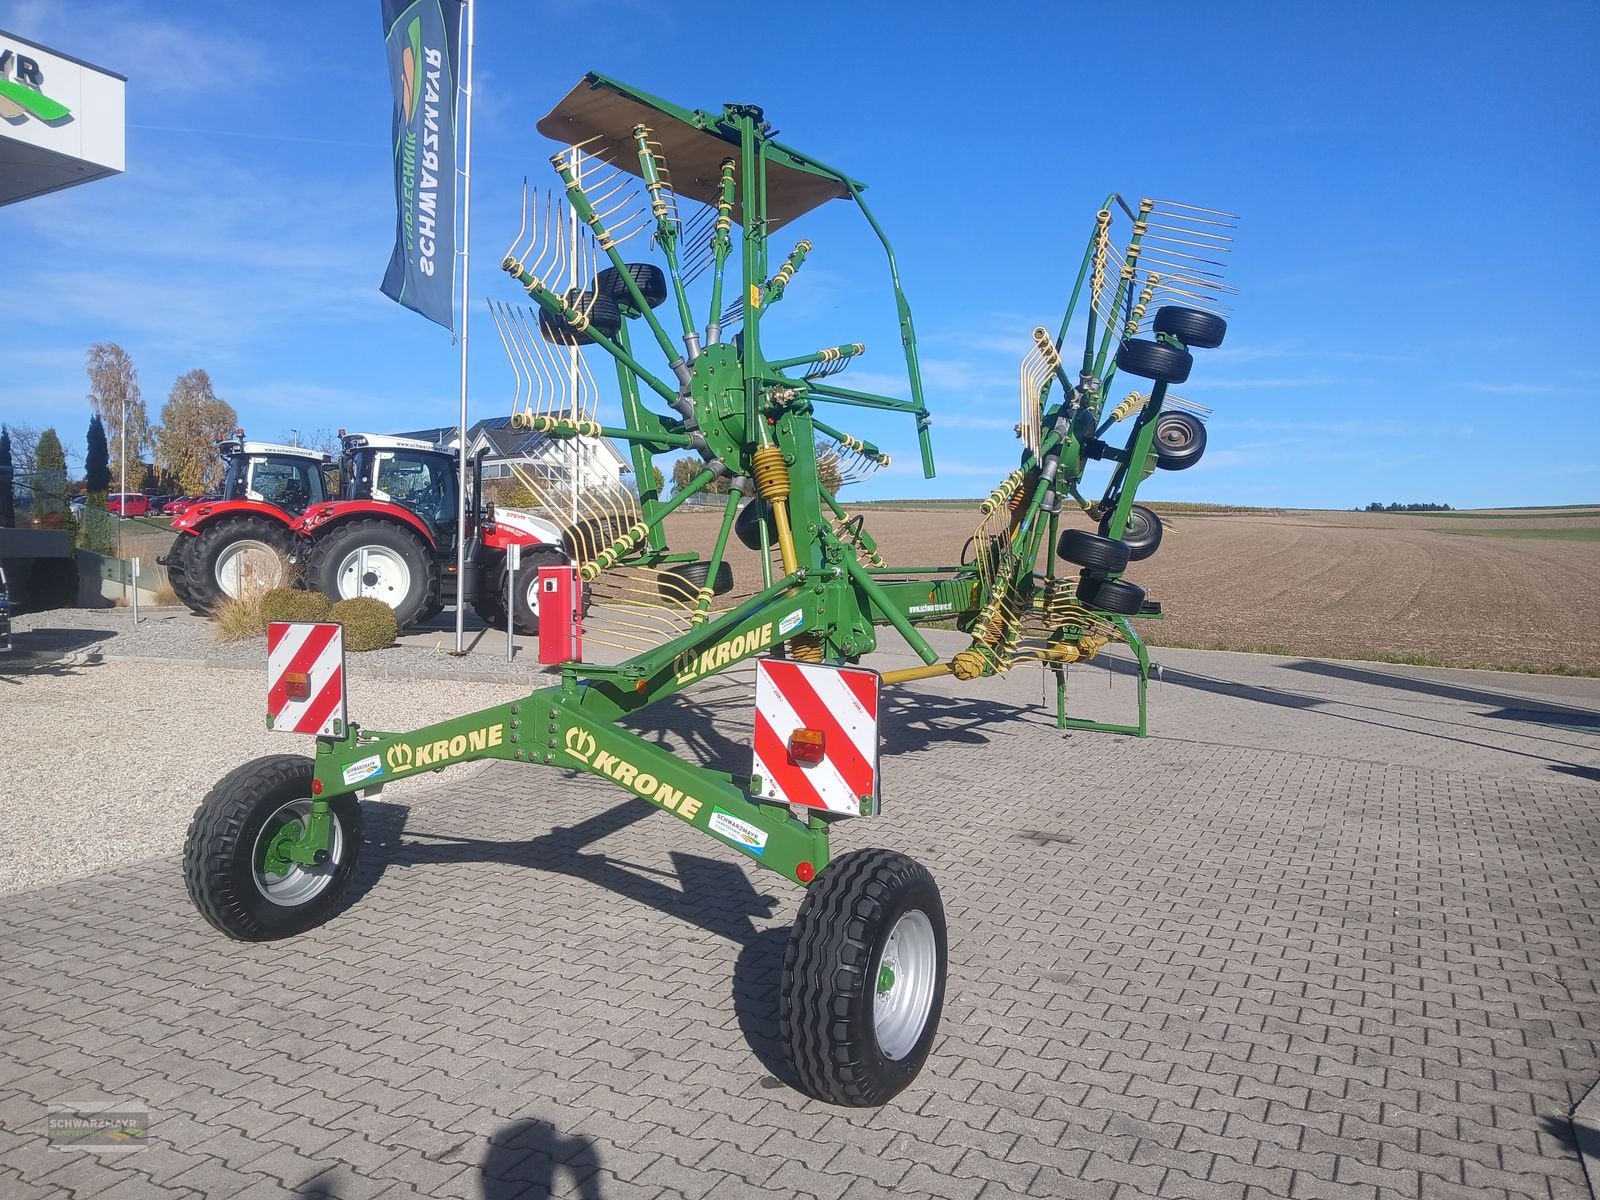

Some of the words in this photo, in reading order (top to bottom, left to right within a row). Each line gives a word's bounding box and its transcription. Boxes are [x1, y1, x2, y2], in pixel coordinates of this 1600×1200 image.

[506, 512, 526, 520] STEYR
[700, 622, 772, 674] KRONE
[415, 723, 503, 767] KRONE
[592, 749, 704, 820] KRONE
[716, 813, 759, 839] SCHWARZMAYR
